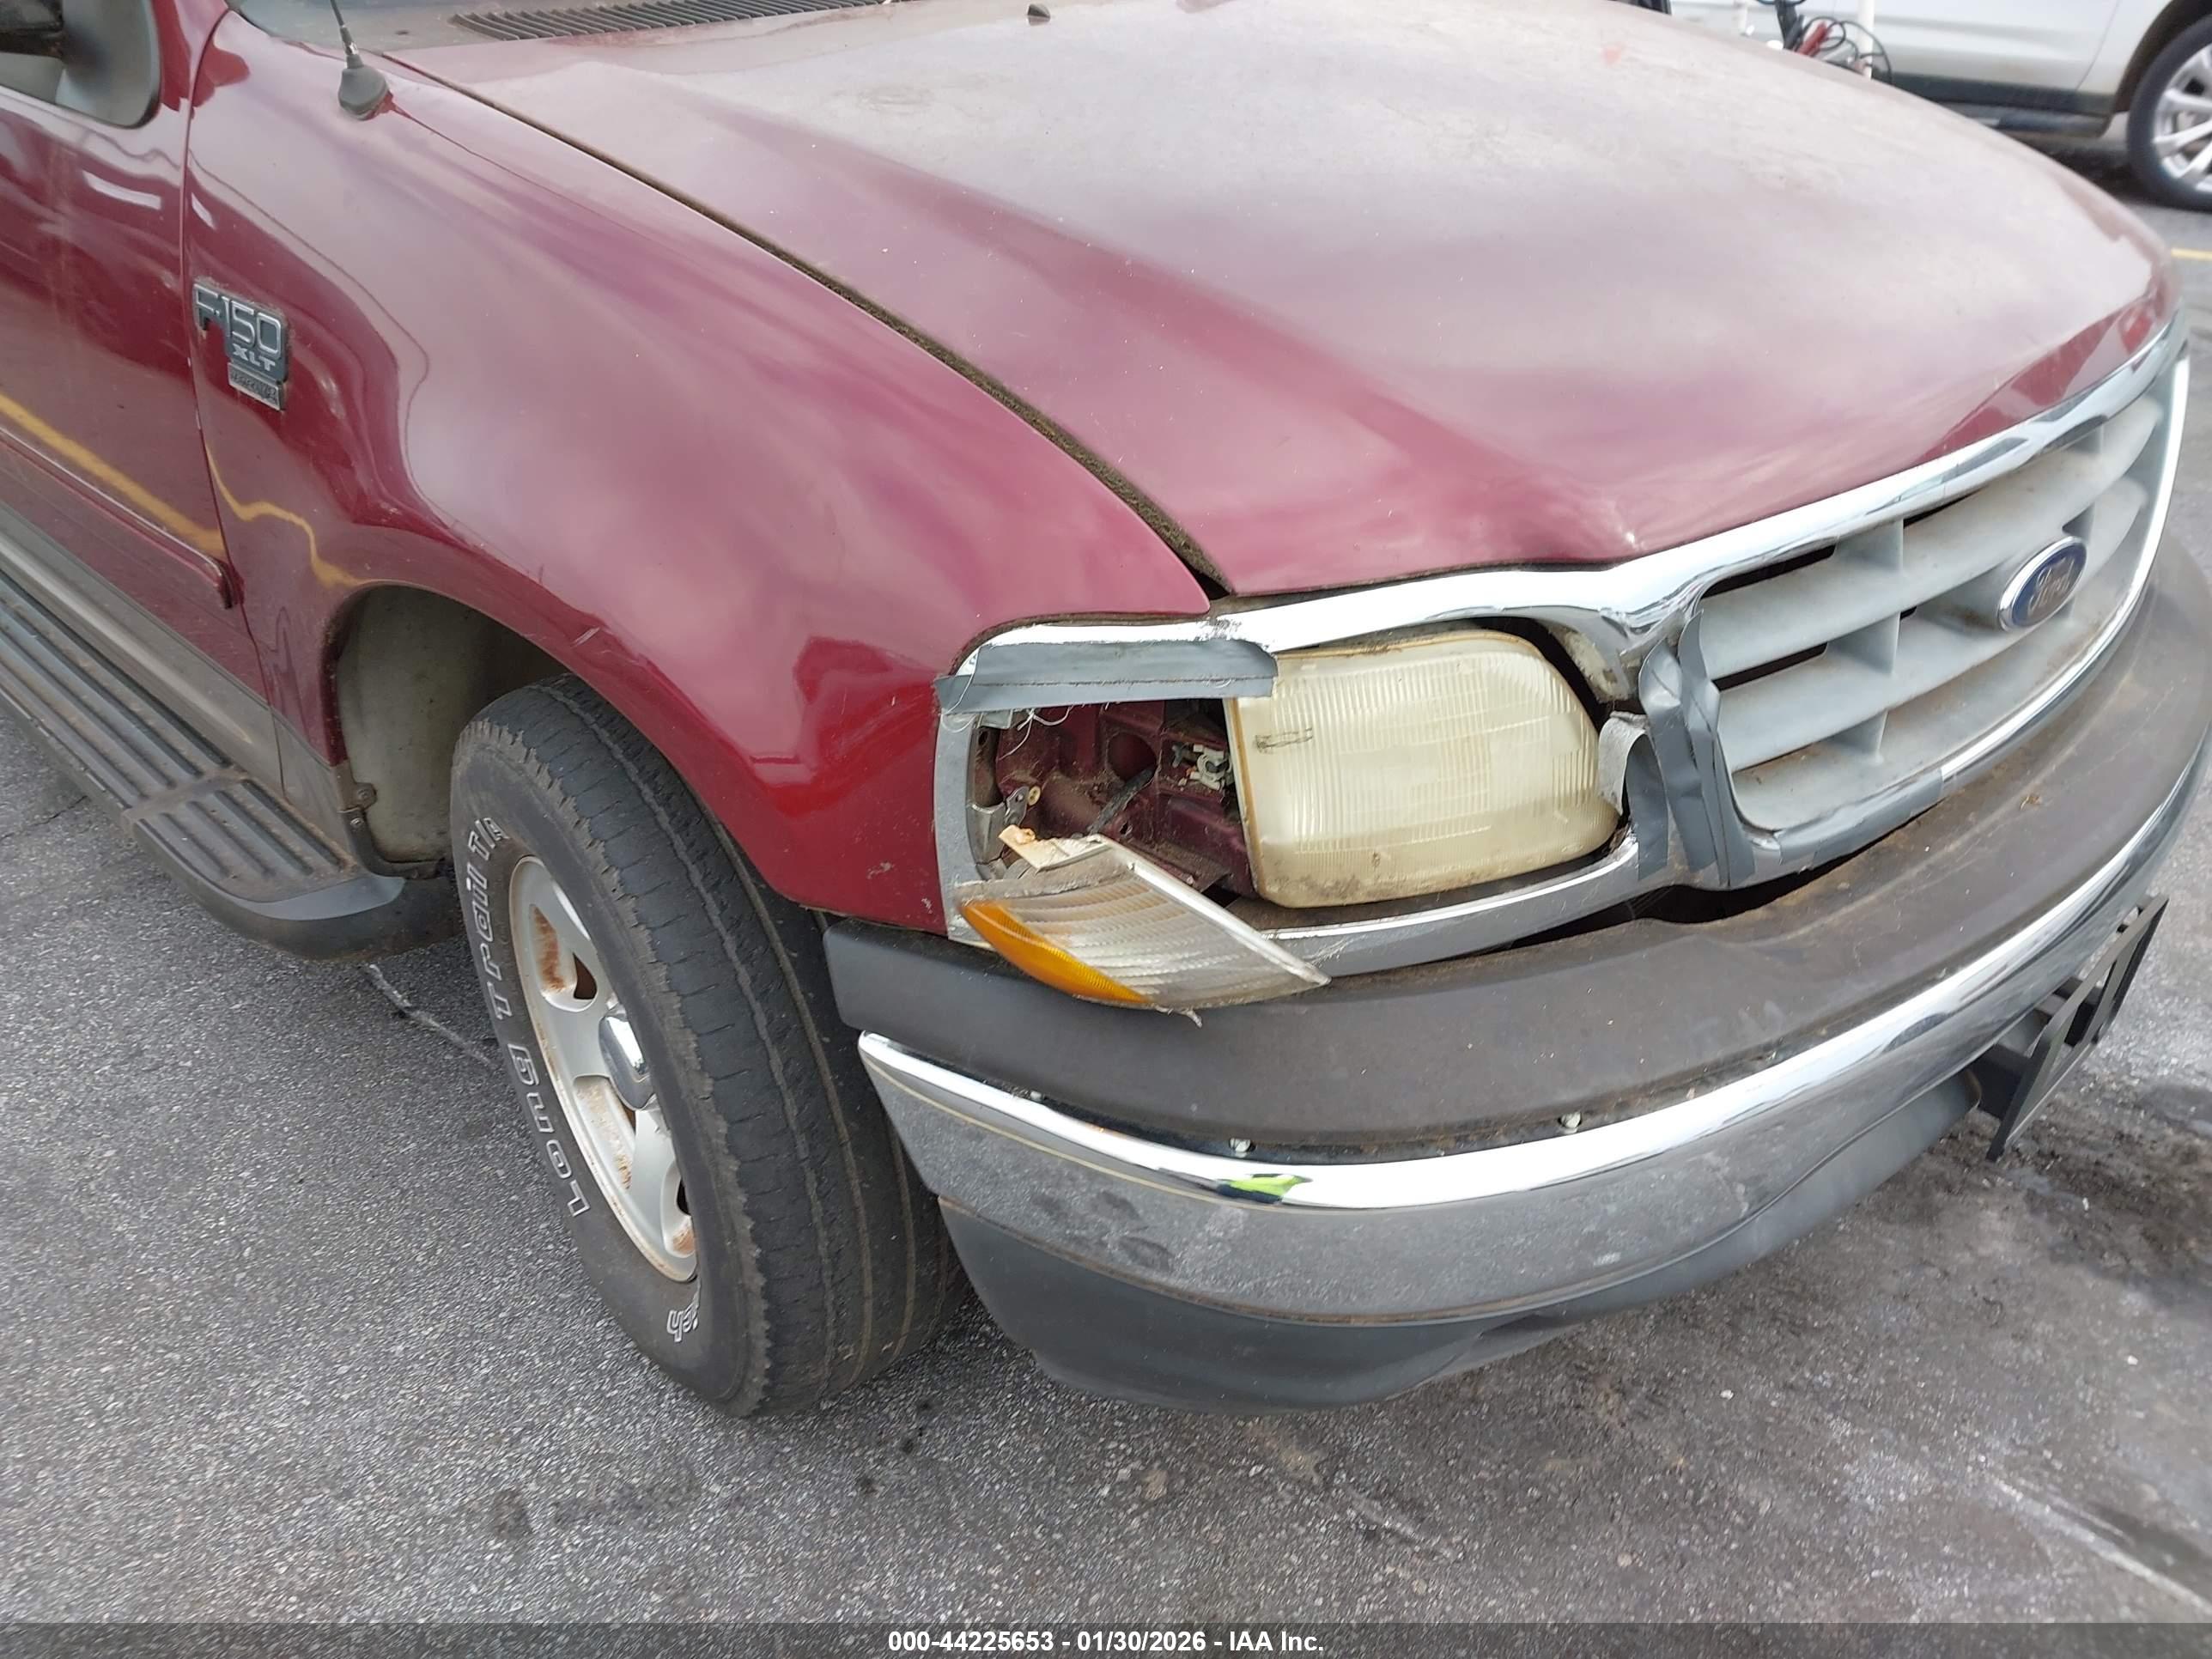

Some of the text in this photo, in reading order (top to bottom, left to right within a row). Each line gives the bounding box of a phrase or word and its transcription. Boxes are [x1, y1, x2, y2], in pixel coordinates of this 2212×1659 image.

[232, 343, 276, 372] XLT
[466, 861, 513, 1020] Trail
[507, 1043, 591, 1218] Long
